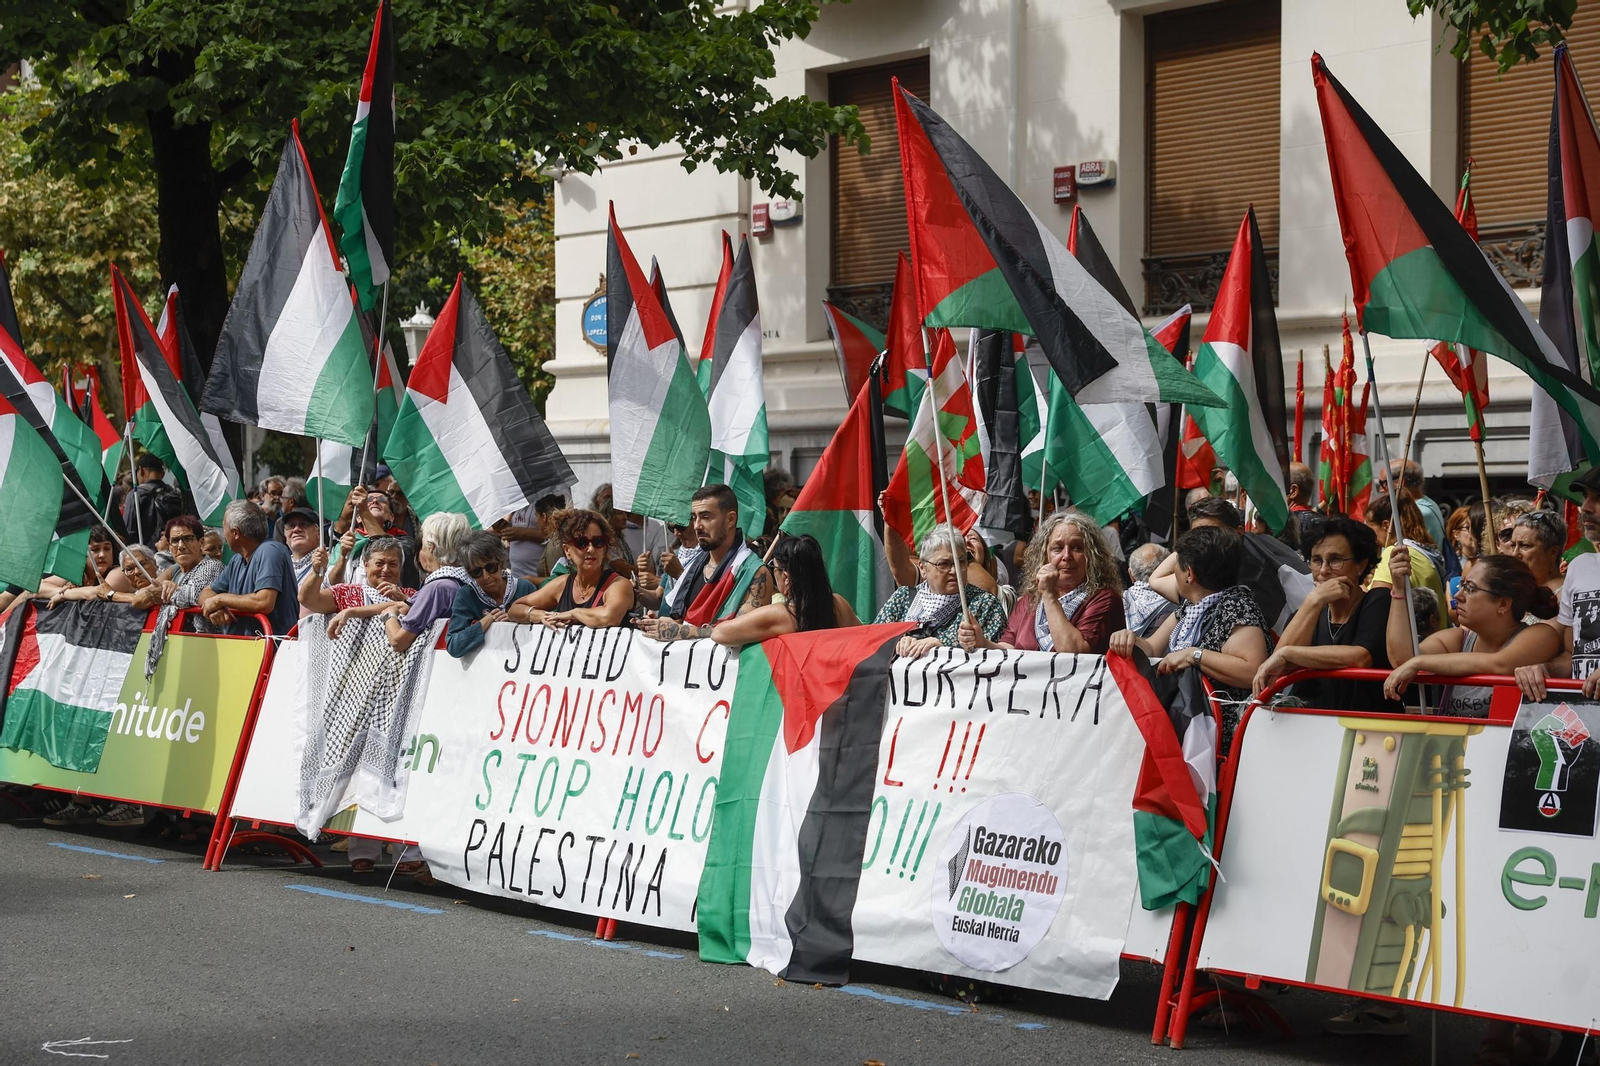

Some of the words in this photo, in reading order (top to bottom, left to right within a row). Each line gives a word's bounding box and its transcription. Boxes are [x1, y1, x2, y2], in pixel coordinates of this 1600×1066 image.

[1080, 162, 1101, 172] ABRA
[490, 680, 665, 758] SIONISMO
[475, 749, 591, 821] STOP
[973, 826, 1061, 865] Gazarako
[464, 819, 667, 916] PALESTINA
[965, 859, 1058, 895] Mugimendu
[957, 886, 1025, 922] Globala
[952, 915, 986, 937] Euskal
[987, 921, 1020, 943] Herria
